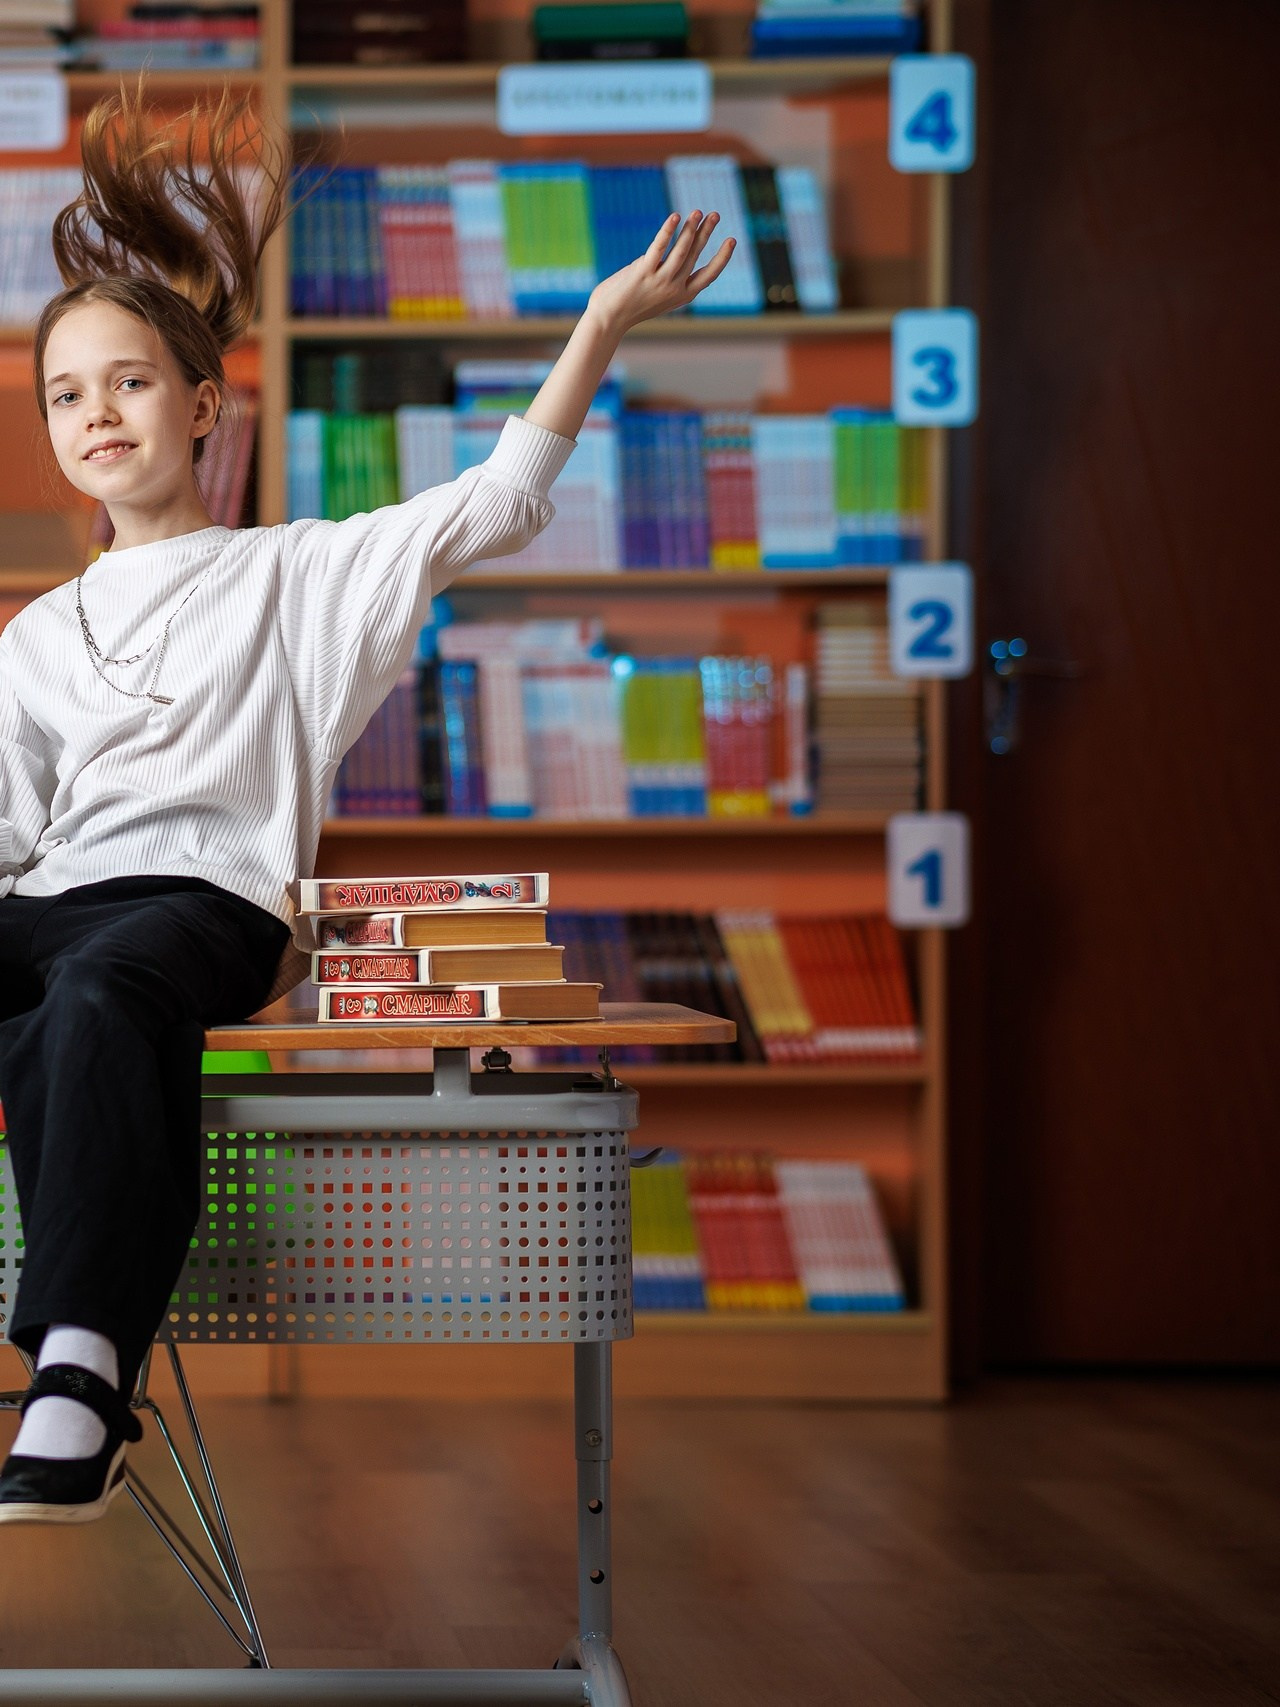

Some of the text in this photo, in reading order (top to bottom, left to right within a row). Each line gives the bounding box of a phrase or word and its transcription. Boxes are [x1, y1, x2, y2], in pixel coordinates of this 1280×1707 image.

[904, 88, 959, 154] 4
[910, 347, 959, 409] 3
[907, 600, 955, 659] 2
[491, 883, 513, 898] 2
[906, 848, 942, 909] 1
[329, 962, 339, 977] 3
[346, 998, 362, 1013] 3
